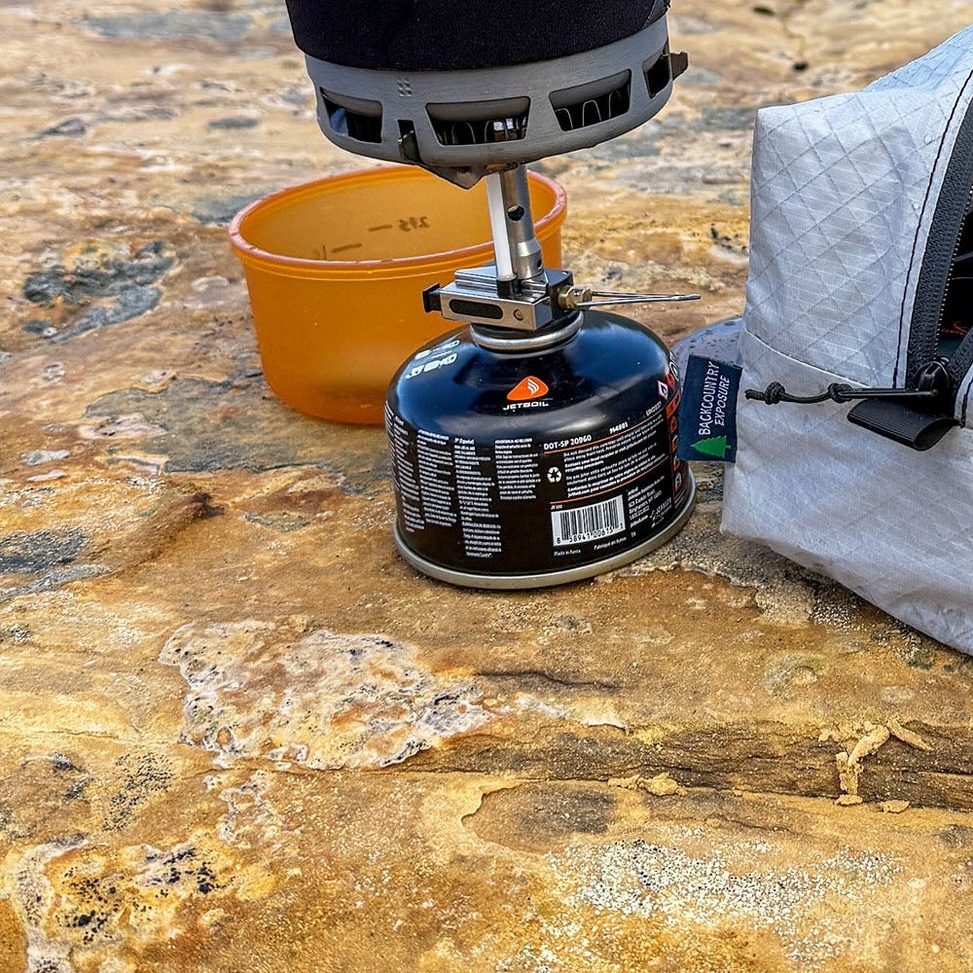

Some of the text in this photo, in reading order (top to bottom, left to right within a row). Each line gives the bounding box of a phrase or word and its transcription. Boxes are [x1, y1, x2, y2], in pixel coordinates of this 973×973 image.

[502, 401, 549, 411] JETBOIL
[698, 361, 720, 436] BACKCOUNTRY
[714, 374, 730, 426] EXPOSURE
[543, 440, 570, 450] DOT-SP
